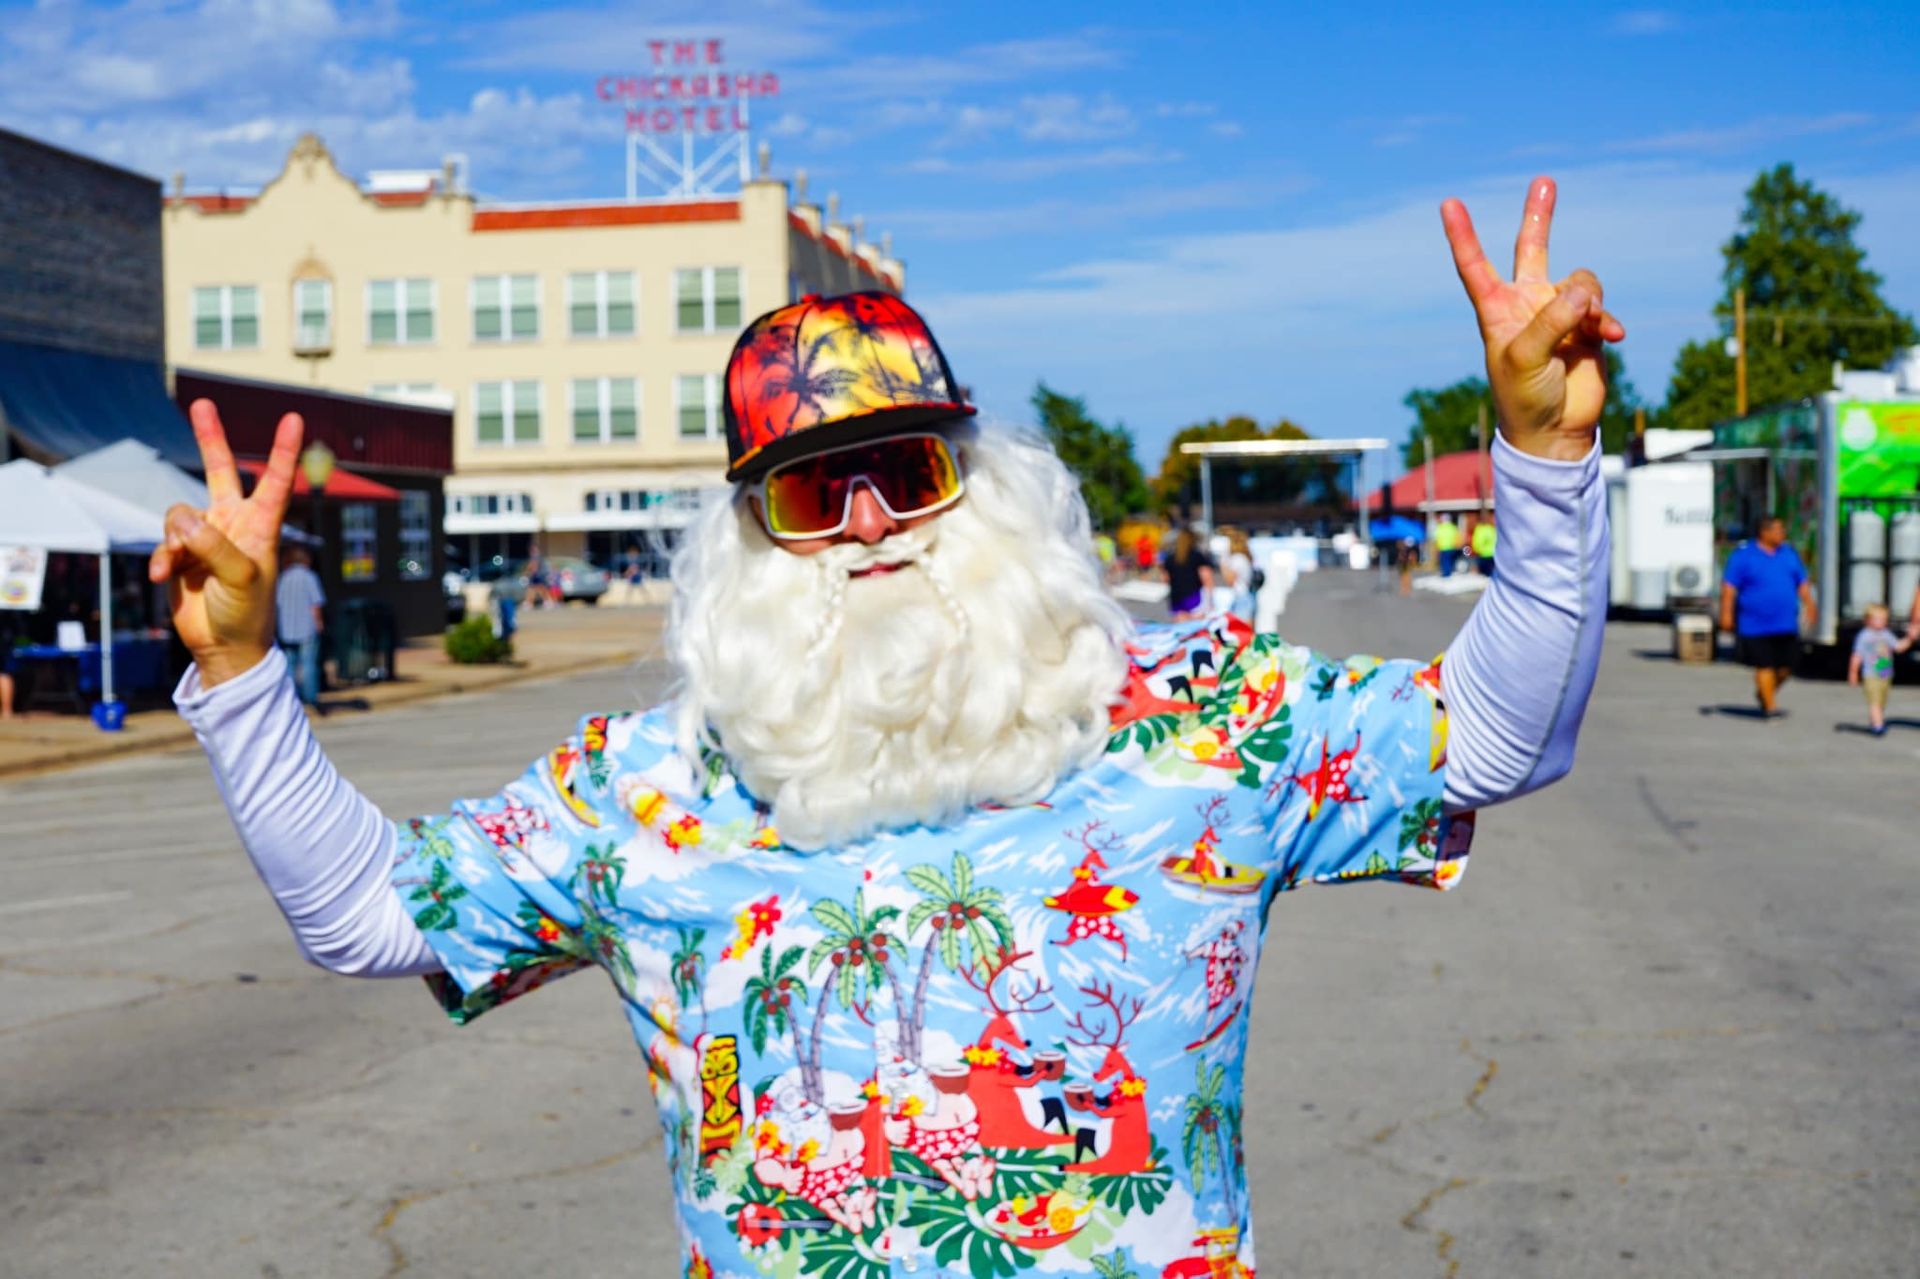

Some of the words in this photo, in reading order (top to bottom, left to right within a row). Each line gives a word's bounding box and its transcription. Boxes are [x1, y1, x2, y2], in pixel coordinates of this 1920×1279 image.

[648, 38, 722, 64] THE
[596, 72, 779, 100] CHICKASHA
[625, 106, 749, 132] HOTEL
